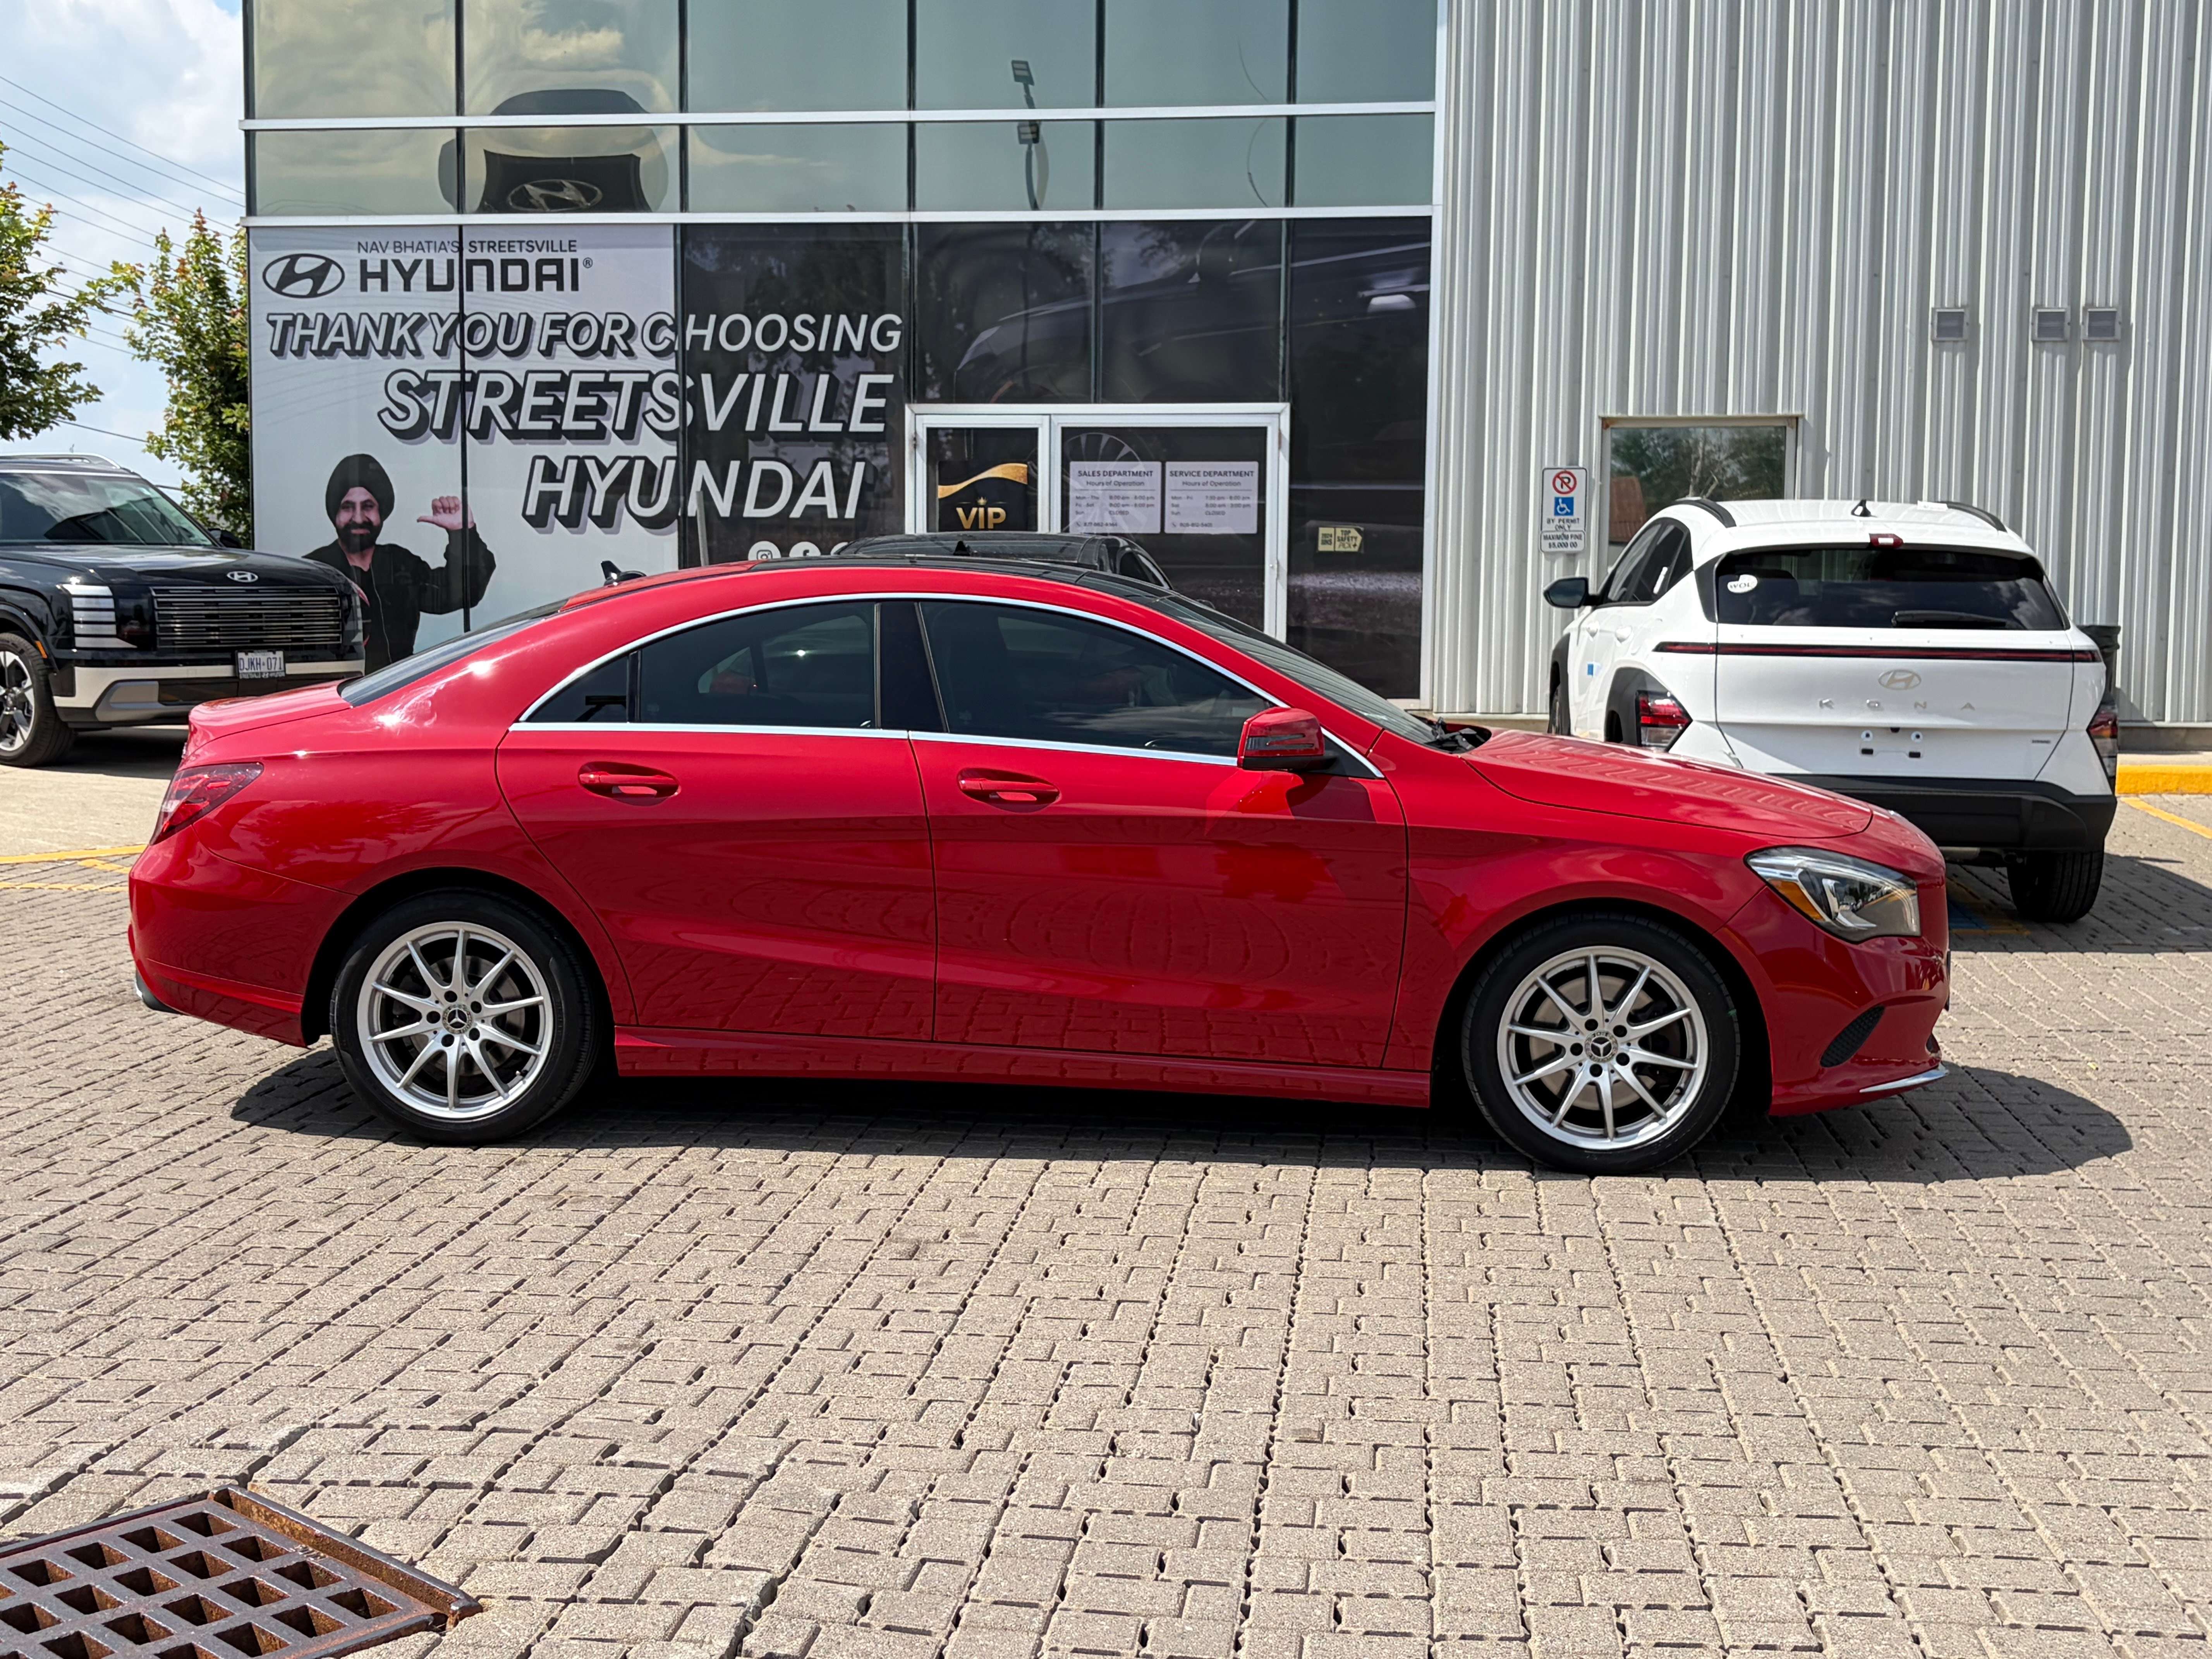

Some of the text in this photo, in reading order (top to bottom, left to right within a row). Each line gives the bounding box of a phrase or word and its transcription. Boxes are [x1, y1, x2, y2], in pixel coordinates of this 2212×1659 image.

[357, 239, 577, 254] NAV BHATIA'S STREETSVILLE
[267, 312, 903, 358] THANK YOU FOR CHOOSING
[377, 369, 895, 441] STREETSVILLE
[521, 455, 866, 527] HYUNDAI
[956, 507, 1006, 529] VIP
[1819, 698, 1975, 711] KONA
